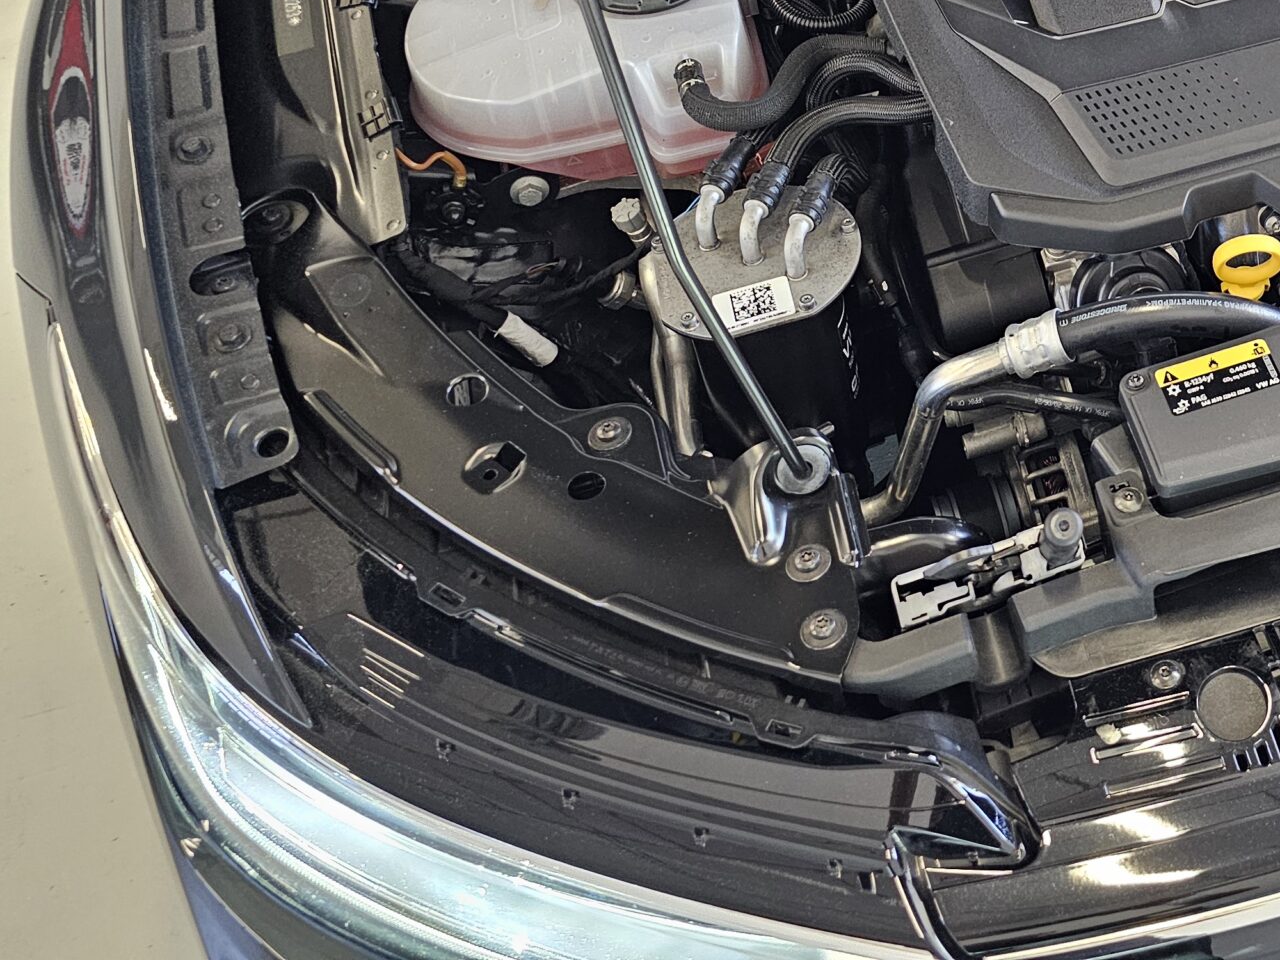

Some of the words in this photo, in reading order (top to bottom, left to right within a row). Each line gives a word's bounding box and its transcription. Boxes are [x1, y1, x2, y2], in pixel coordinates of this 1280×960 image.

[1070, 304, 1127, 324] BRIDGESTONE
[1255, 380, 1269, 389] VW
[1269, 377, 1280, 386] AG
[1191, 393, 1208, 405] PAG
